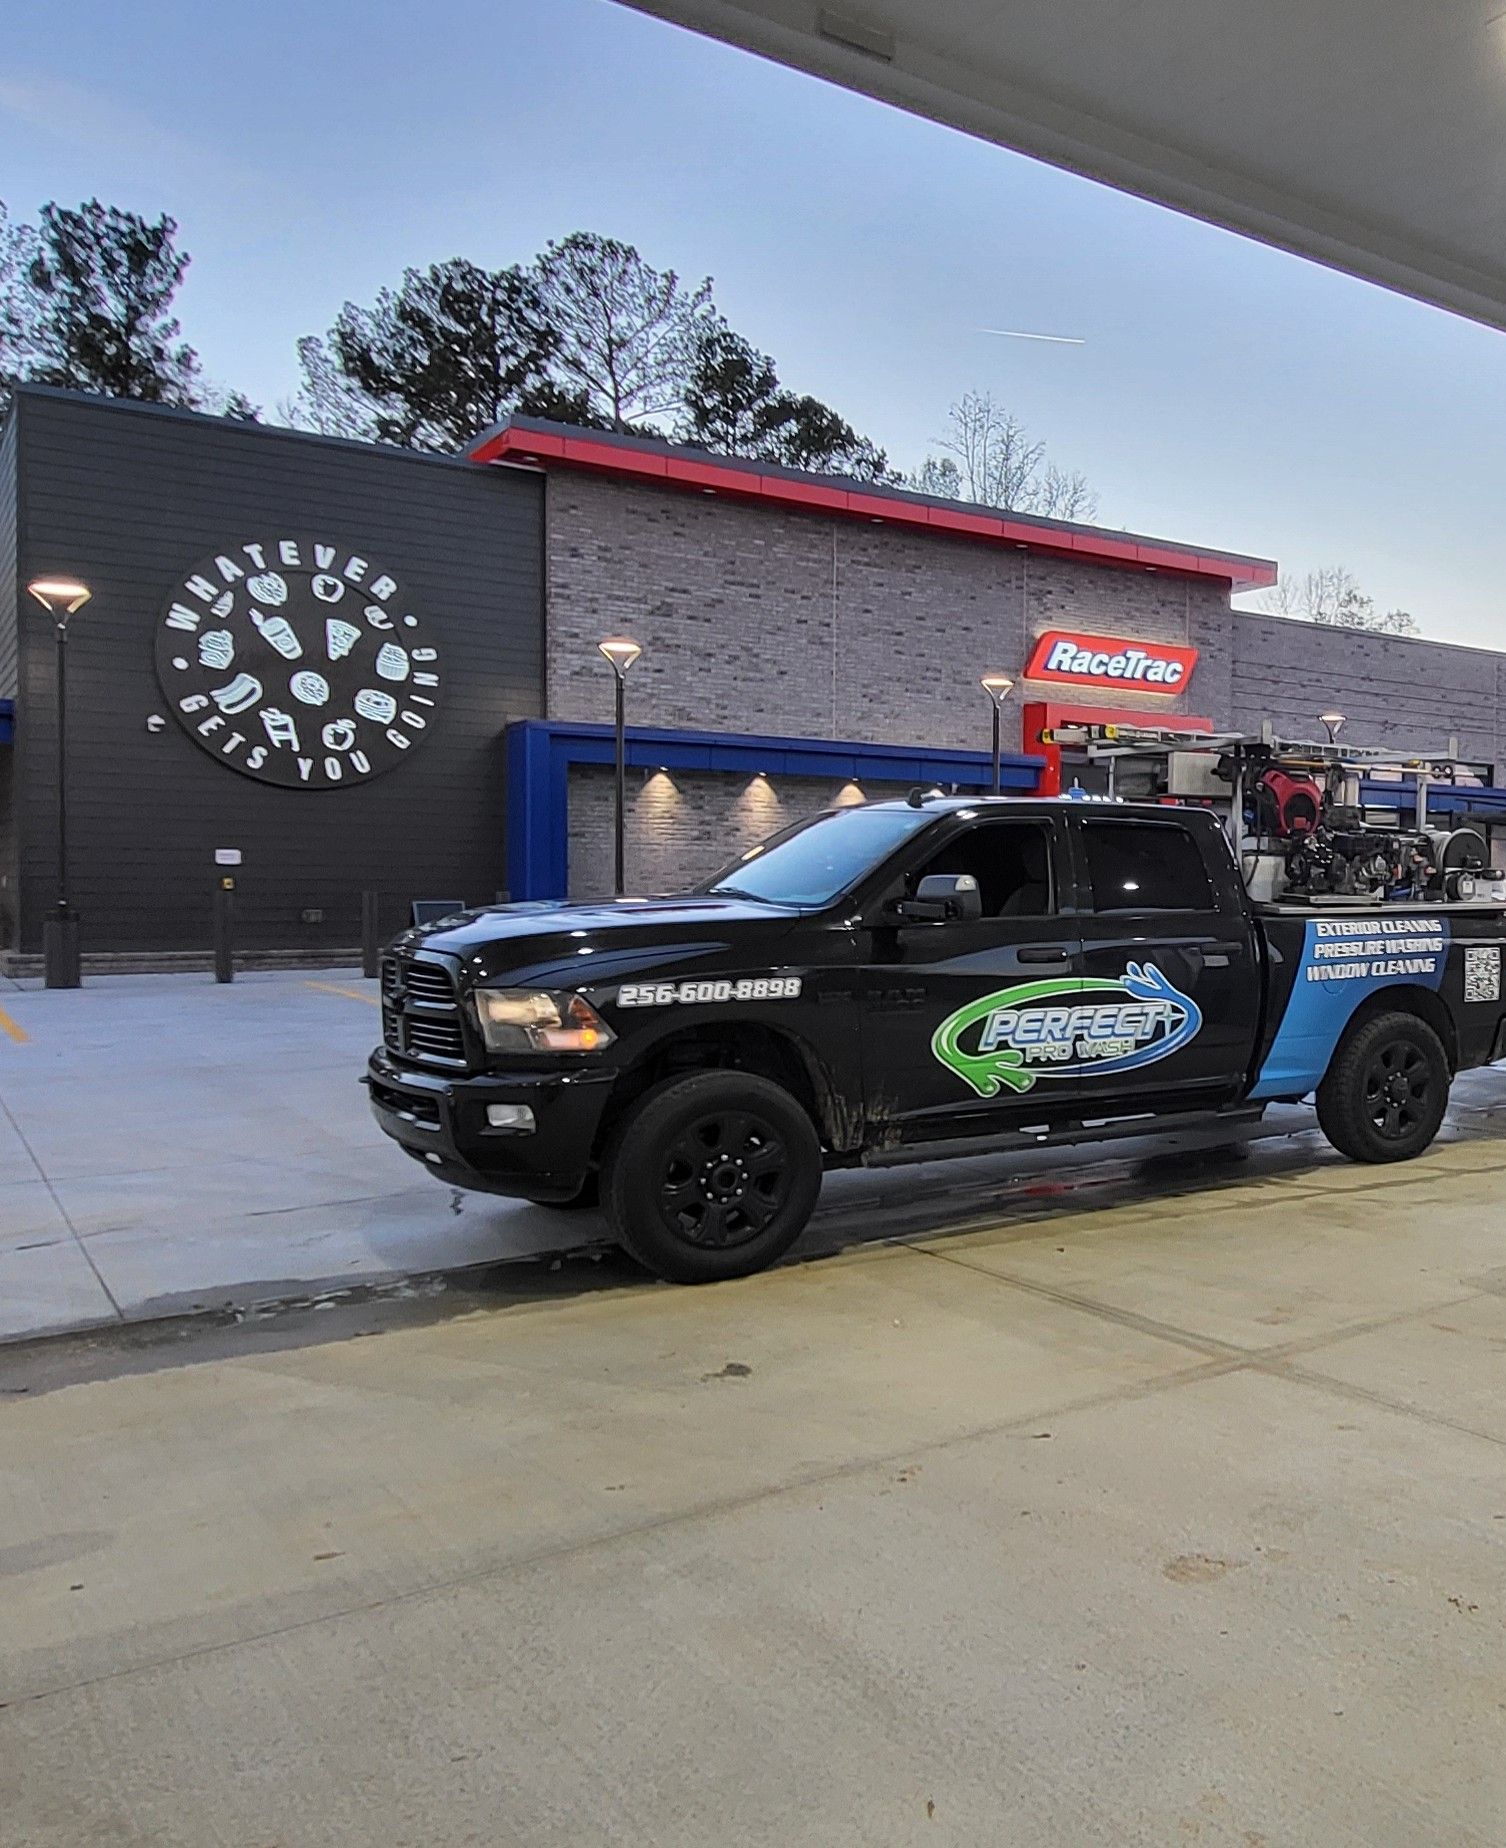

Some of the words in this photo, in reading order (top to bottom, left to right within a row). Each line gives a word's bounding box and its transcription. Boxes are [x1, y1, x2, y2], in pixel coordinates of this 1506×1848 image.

[165, 540, 398, 632] WHATEVER
[1046, 640, 1184, 684] RaceTrac
[179, 694, 269, 770] GETS
[297, 750, 371, 781] YOU
[386, 647, 440, 750] GOING
[1316, 921, 1382, 936] EXTERIOR
[1382, 919, 1443, 934] CLEANING
[1313, 940, 1385, 959] PRESSURE
[1306, 962, 1370, 981] WINDOW
[1370, 958, 1436, 976] CLEANING
[618, 978, 801, 1008] 256-600-8898
[978, 1003, 1167, 1051] PERFECT
[1025, 1043, 1073, 1063] PRO
